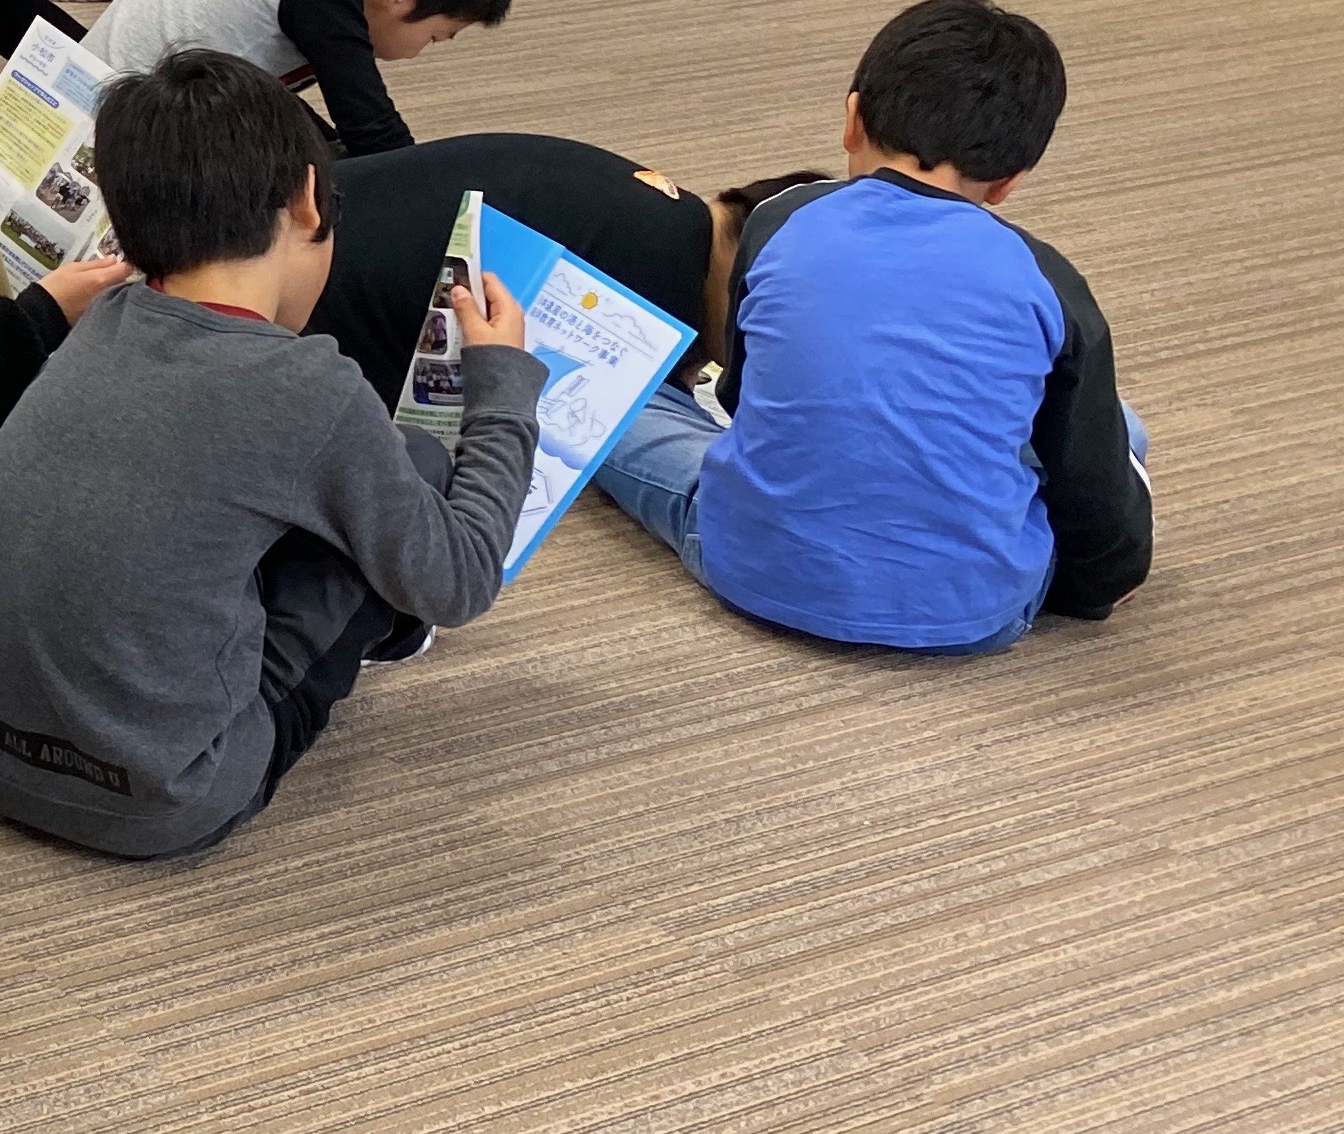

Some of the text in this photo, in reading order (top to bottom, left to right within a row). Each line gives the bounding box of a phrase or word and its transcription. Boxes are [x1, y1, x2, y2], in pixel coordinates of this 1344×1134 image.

[31, 43, 56, 62] 小松市
[4, 730, 32, 758] ALL
[40, 742, 105, 782] AROUND
[108, 769, 121, 787] U
